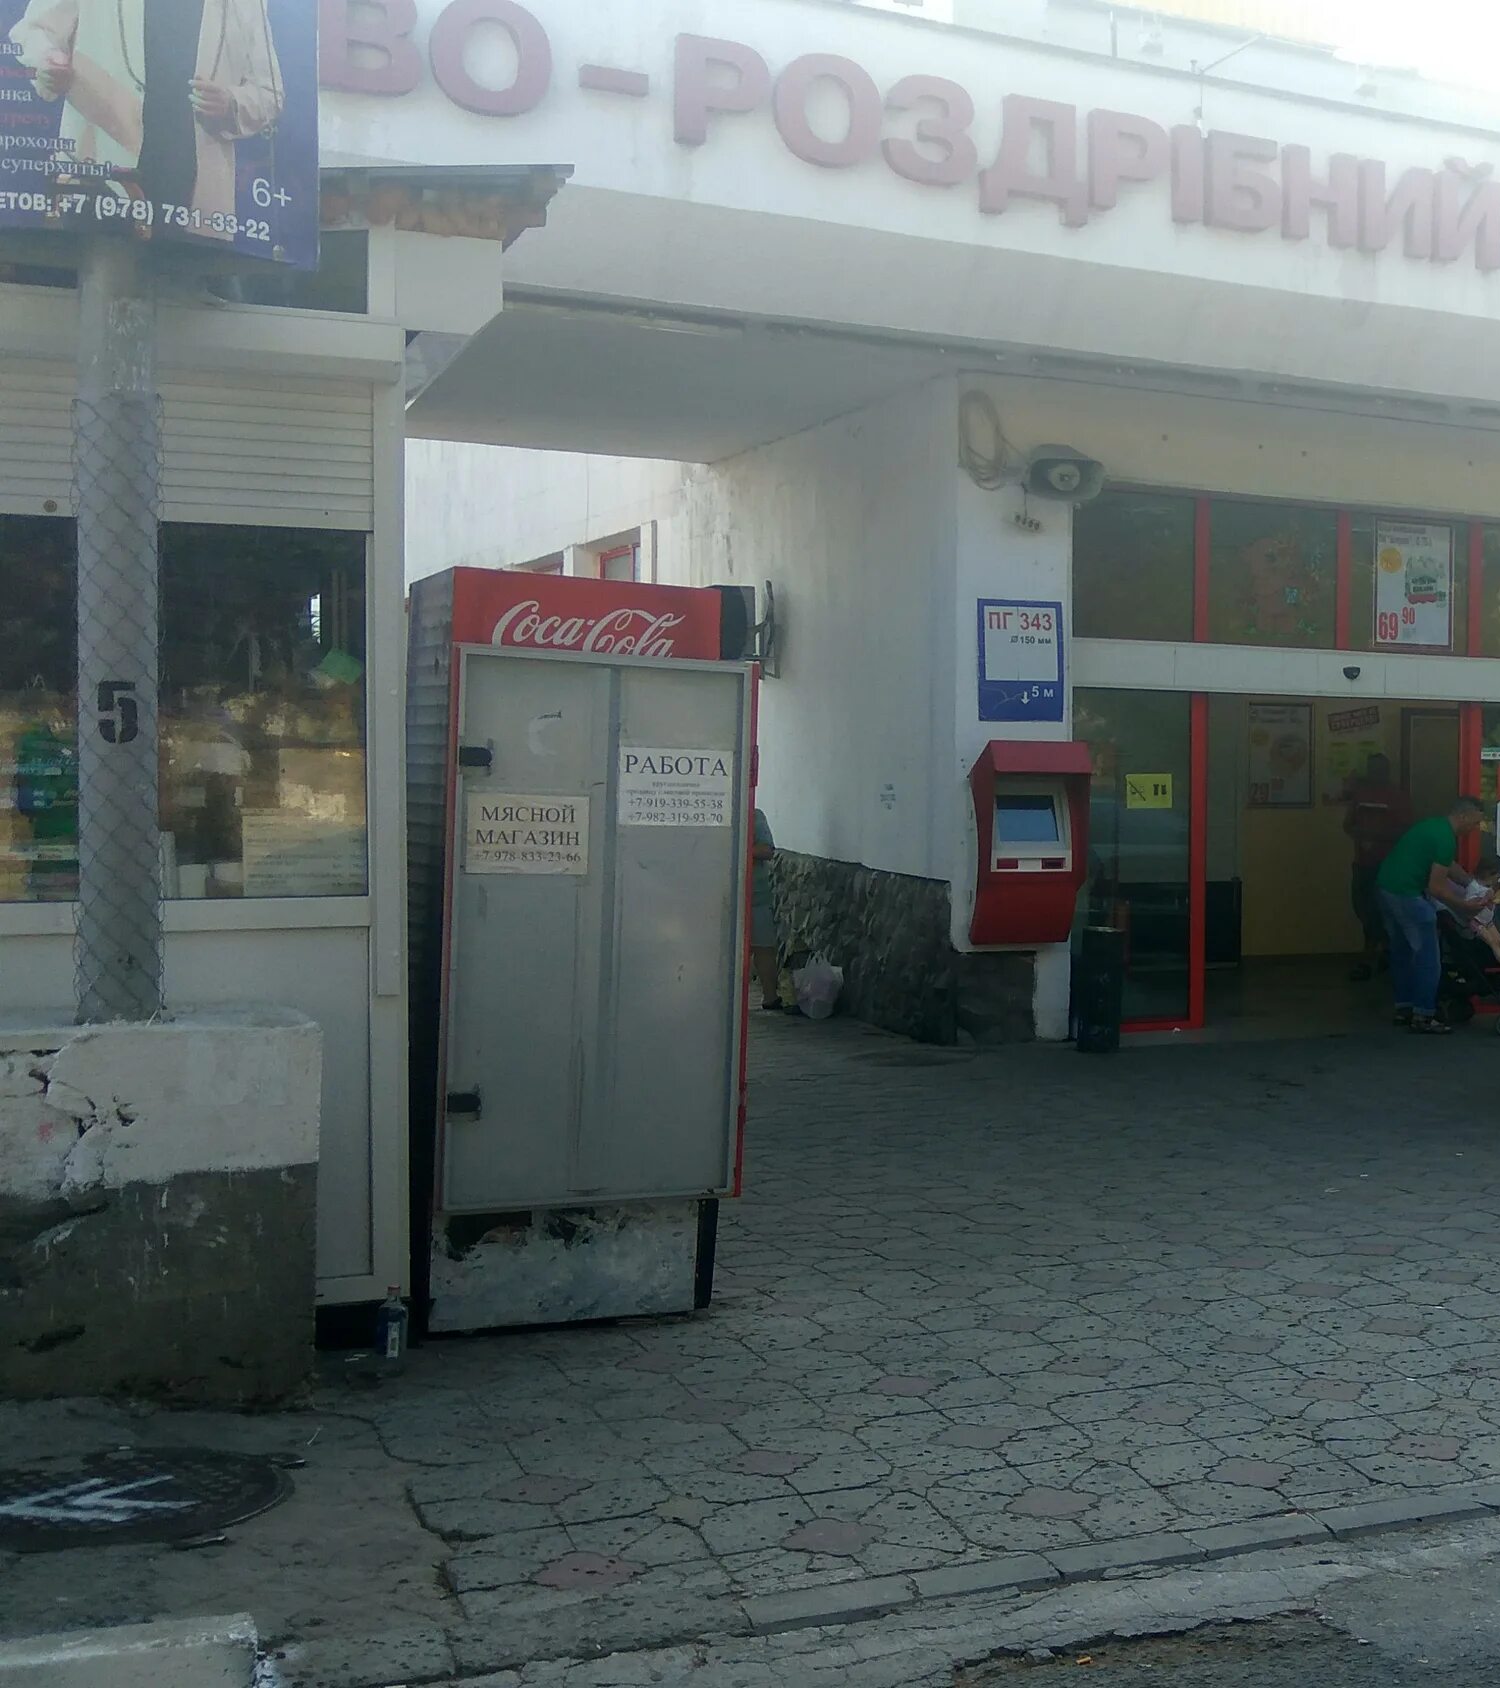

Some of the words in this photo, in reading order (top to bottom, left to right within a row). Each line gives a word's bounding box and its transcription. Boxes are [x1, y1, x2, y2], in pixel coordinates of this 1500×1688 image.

[2, 156, 111, 177] суперхиты!
[252, 178, 292, 208] 6+
[59, 194, 86, 213] +7
[162, 204, 270, 241] 731-33-22
[492, 600, 686, 658] Coca-Cola
[988, 611, 1013, 630] ПГ
[1020, 612, 1053, 631] 343
[1020, 636, 1036, 644] 150
[1031, 685, 1040, 698] 5
[97, 681, 139, 743] 5
[624, 754, 728, 776] РАБОТА
[482, 804, 575, 823] МЯСНОЙ
[475, 829, 580, 846] МАГАЗИН
